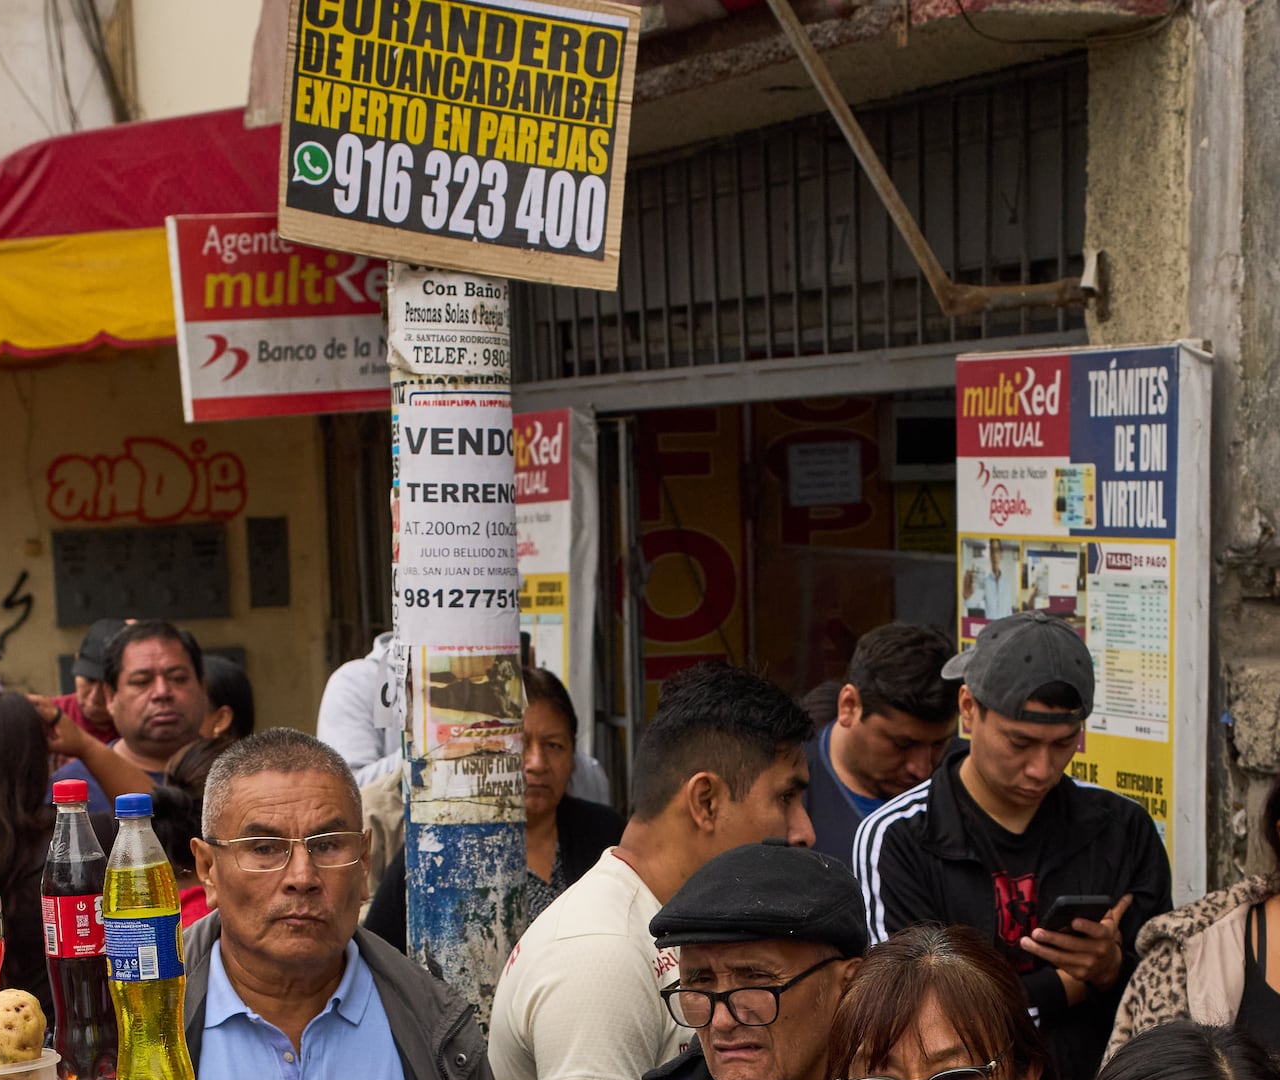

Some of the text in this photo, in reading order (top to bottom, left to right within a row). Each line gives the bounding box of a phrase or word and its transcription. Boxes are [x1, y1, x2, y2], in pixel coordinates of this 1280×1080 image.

[304, 0, 620, 80] CURANDERO
[303, 30, 609, 125] DE HUANCABAMBA
[295, 75, 610, 175] EXPERTO EN PAREJAS
[333, 132, 607, 254] 916 323 400
[204, 253, 387, 310] multiRe
[422, 279, 458, 297] Con
[464, 281, 502, 300] Baño
[404, 301, 443, 324] Personas
[444, 302, 470, 325] Solas
[257, 340, 317, 363] Banco
[323, 339, 347, 360] de
[354, 338, 372, 358] la
[416, 334, 458, 343] SANTIAGO
[413, 345, 478, 367] TELEF.:
[963, 366, 1062, 417] multiRed
[1088, 357, 1169, 418] TRÁMITES
[978, 421, 1044, 448] VIRTUAL
[1114, 422, 1168, 473] DE DNI
[407, 481, 517, 504] TERRENO
[1102, 480, 1168, 529] VIRTUAL
[419, 547, 451, 559] JULIO
[453, 547, 496, 559] BELLIDO
[1107, 553, 1167, 569] TASAS DE PAGO
[422, 566, 441, 576] SAN
[443, 566, 471, 576] JUAN
[472, 566, 486, 576] DE
